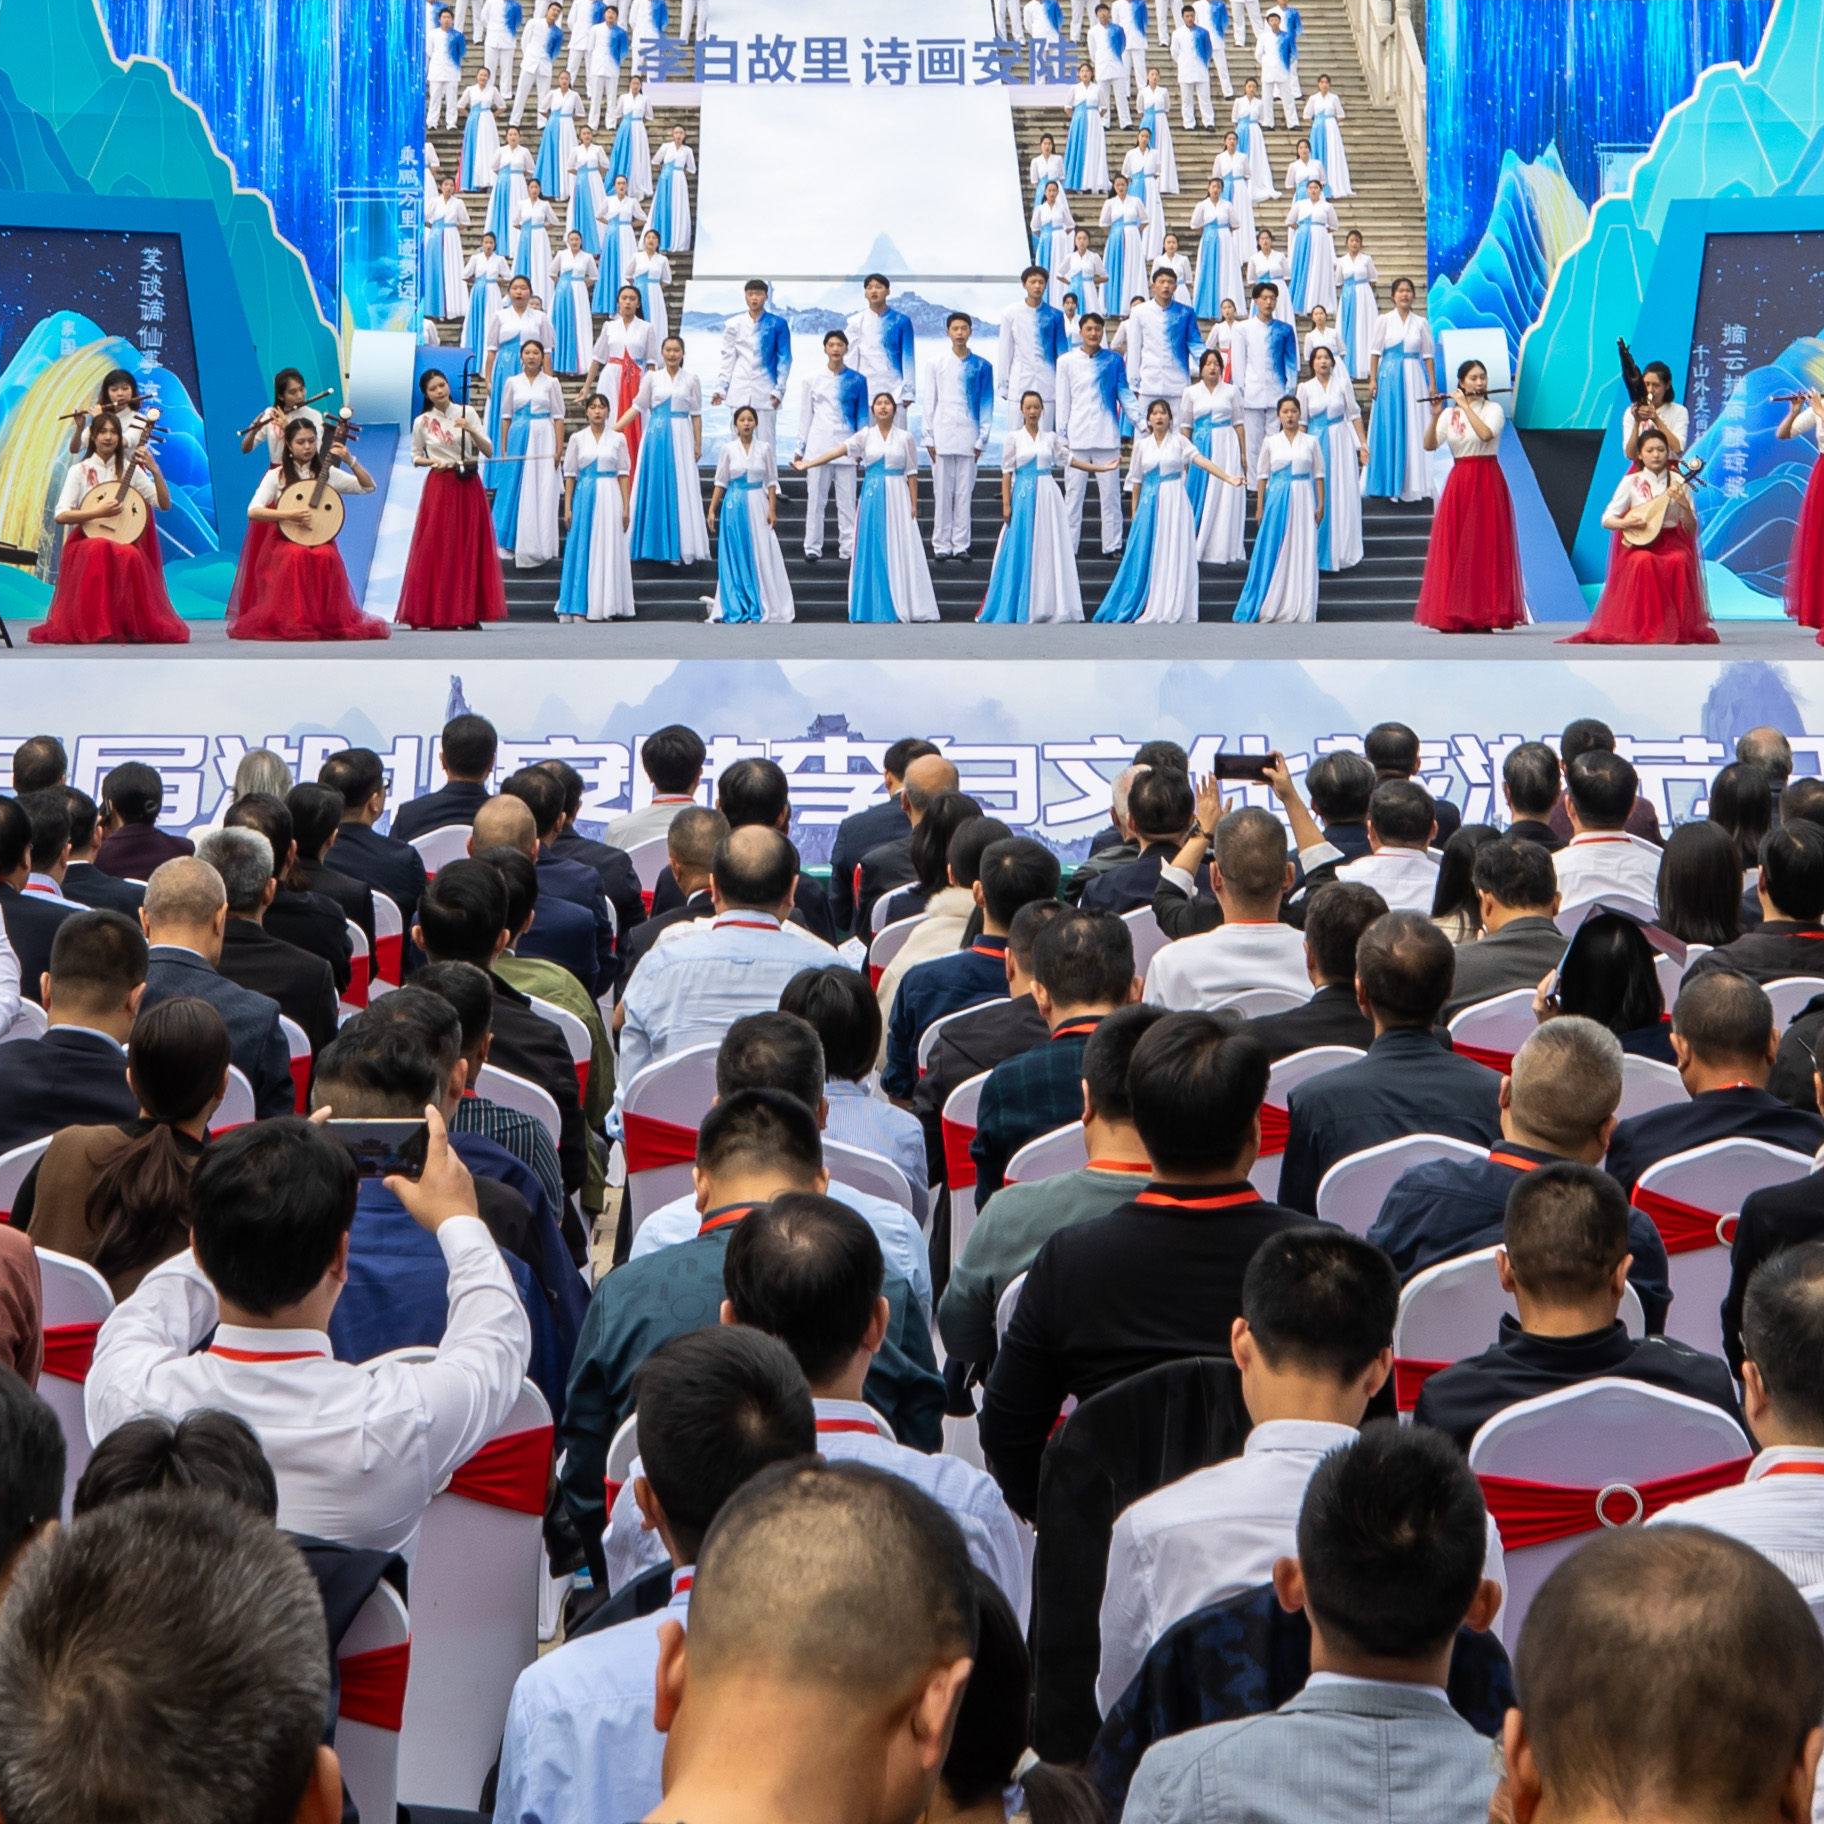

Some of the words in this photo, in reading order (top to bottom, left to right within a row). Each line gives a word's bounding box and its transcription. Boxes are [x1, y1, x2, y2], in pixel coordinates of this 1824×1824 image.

[637, 34, 851, 85] 李白故里
[861, 35, 1079, 86] 诗画安陆
